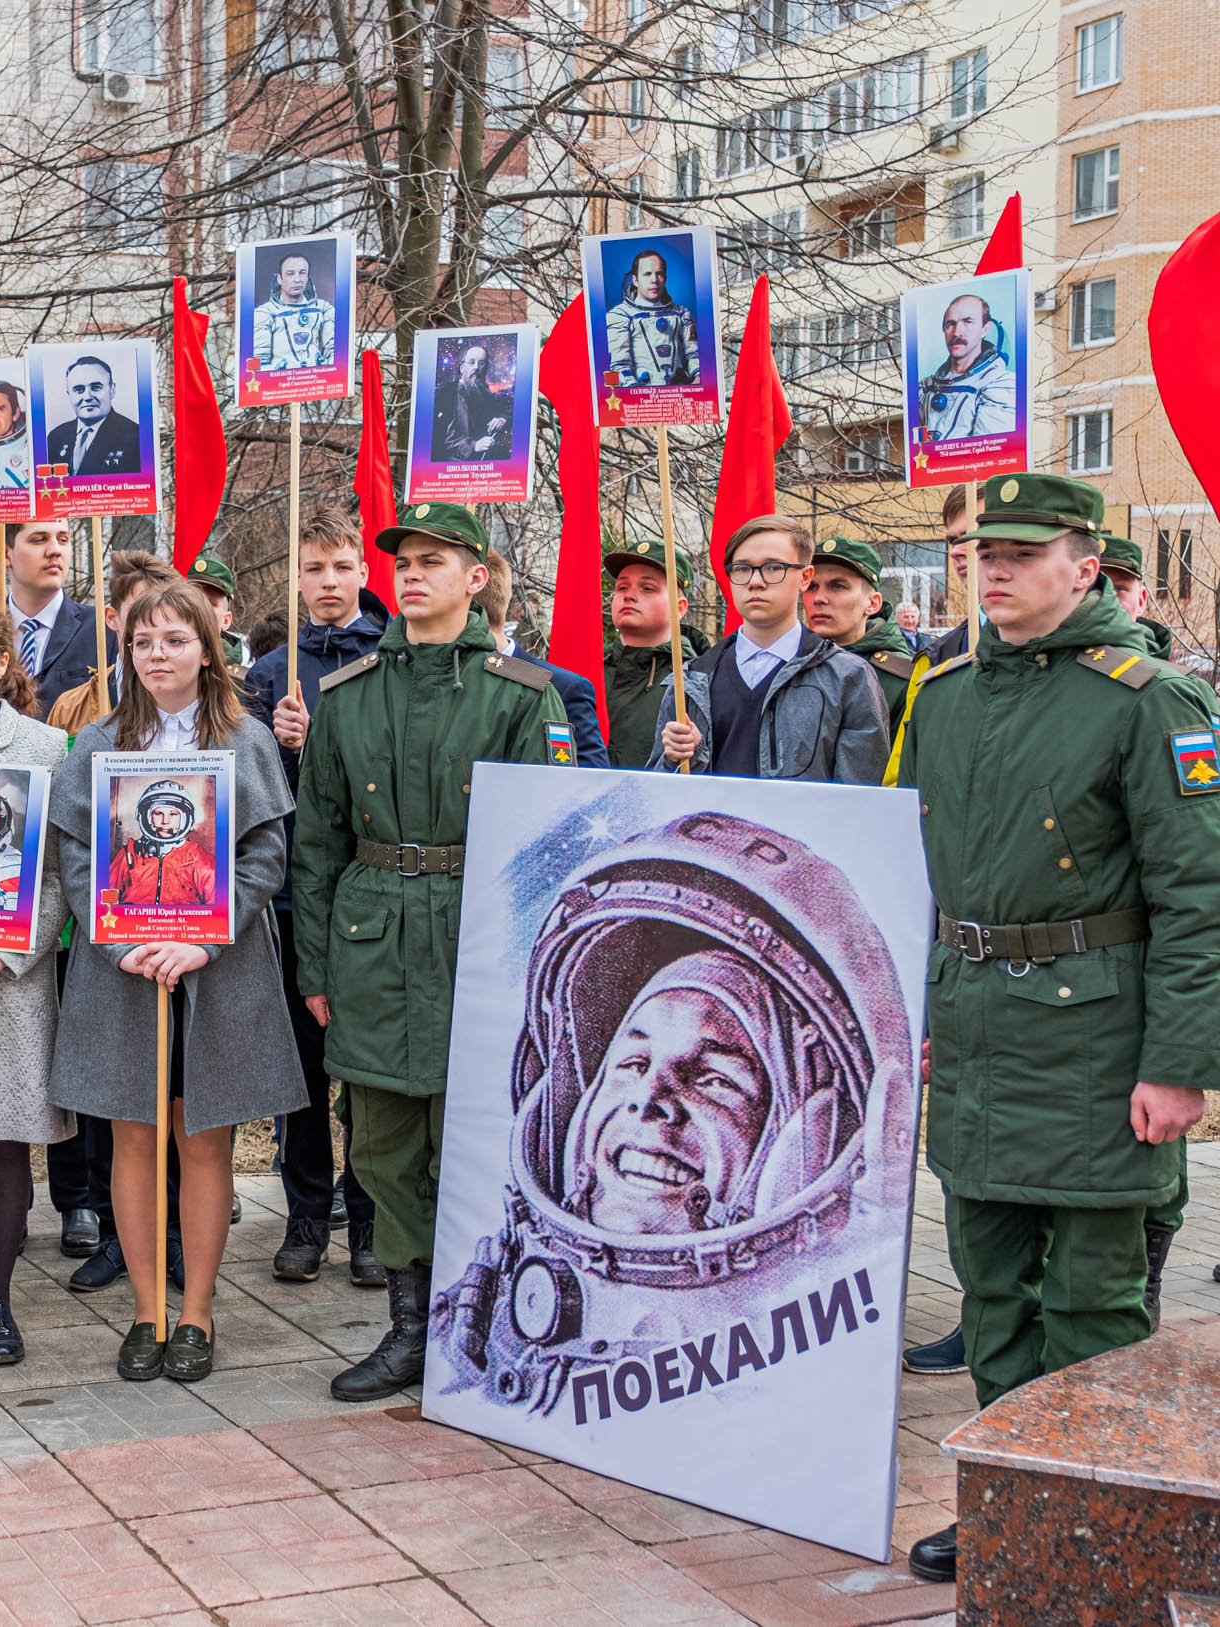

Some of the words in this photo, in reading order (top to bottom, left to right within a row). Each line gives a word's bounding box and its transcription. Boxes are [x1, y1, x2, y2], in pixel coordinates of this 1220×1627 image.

[447, 463, 494, 473] ЦИОЛКОВСКИЙ
[438, 472, 469, 480] Константин
[72, 483, 102, 493] КОРОЛЁВ
[103, 483, 122, 493] Сергей
[123, 482, 150, 490] Павлович
[124, 907, 156, 916] ГАГАРИН
[158, 907, 176, 918] Юрий
[177, 908, 212, 916] Алексеевич
[136, 924, 151, 932] Герой
[571, 1267, 880, 1426] ПОЕХАЛИ!
